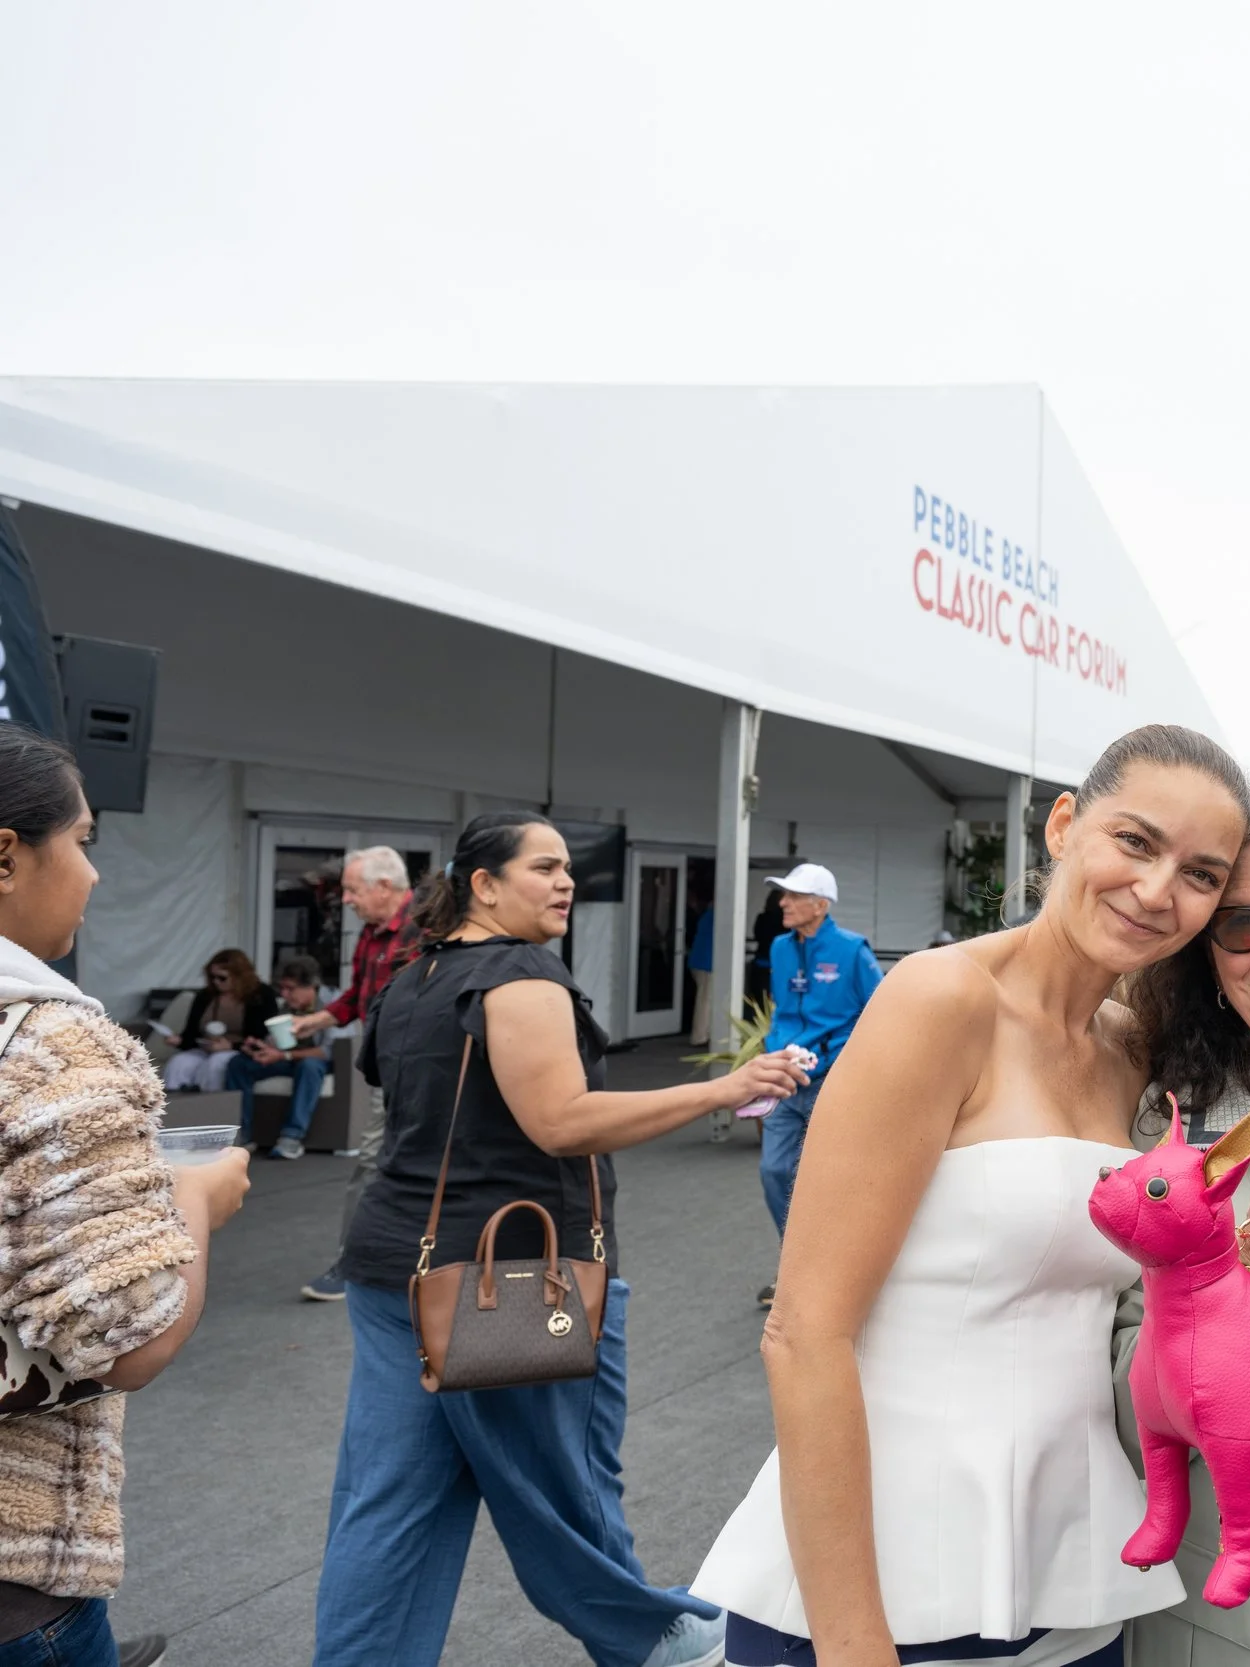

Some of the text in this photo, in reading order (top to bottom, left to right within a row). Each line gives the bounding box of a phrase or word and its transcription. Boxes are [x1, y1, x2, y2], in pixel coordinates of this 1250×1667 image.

[914, 484, 1059, 608] PEBBLE BEACH
[913, 548, 1127, 697] CLASSIC CAR FORUM
